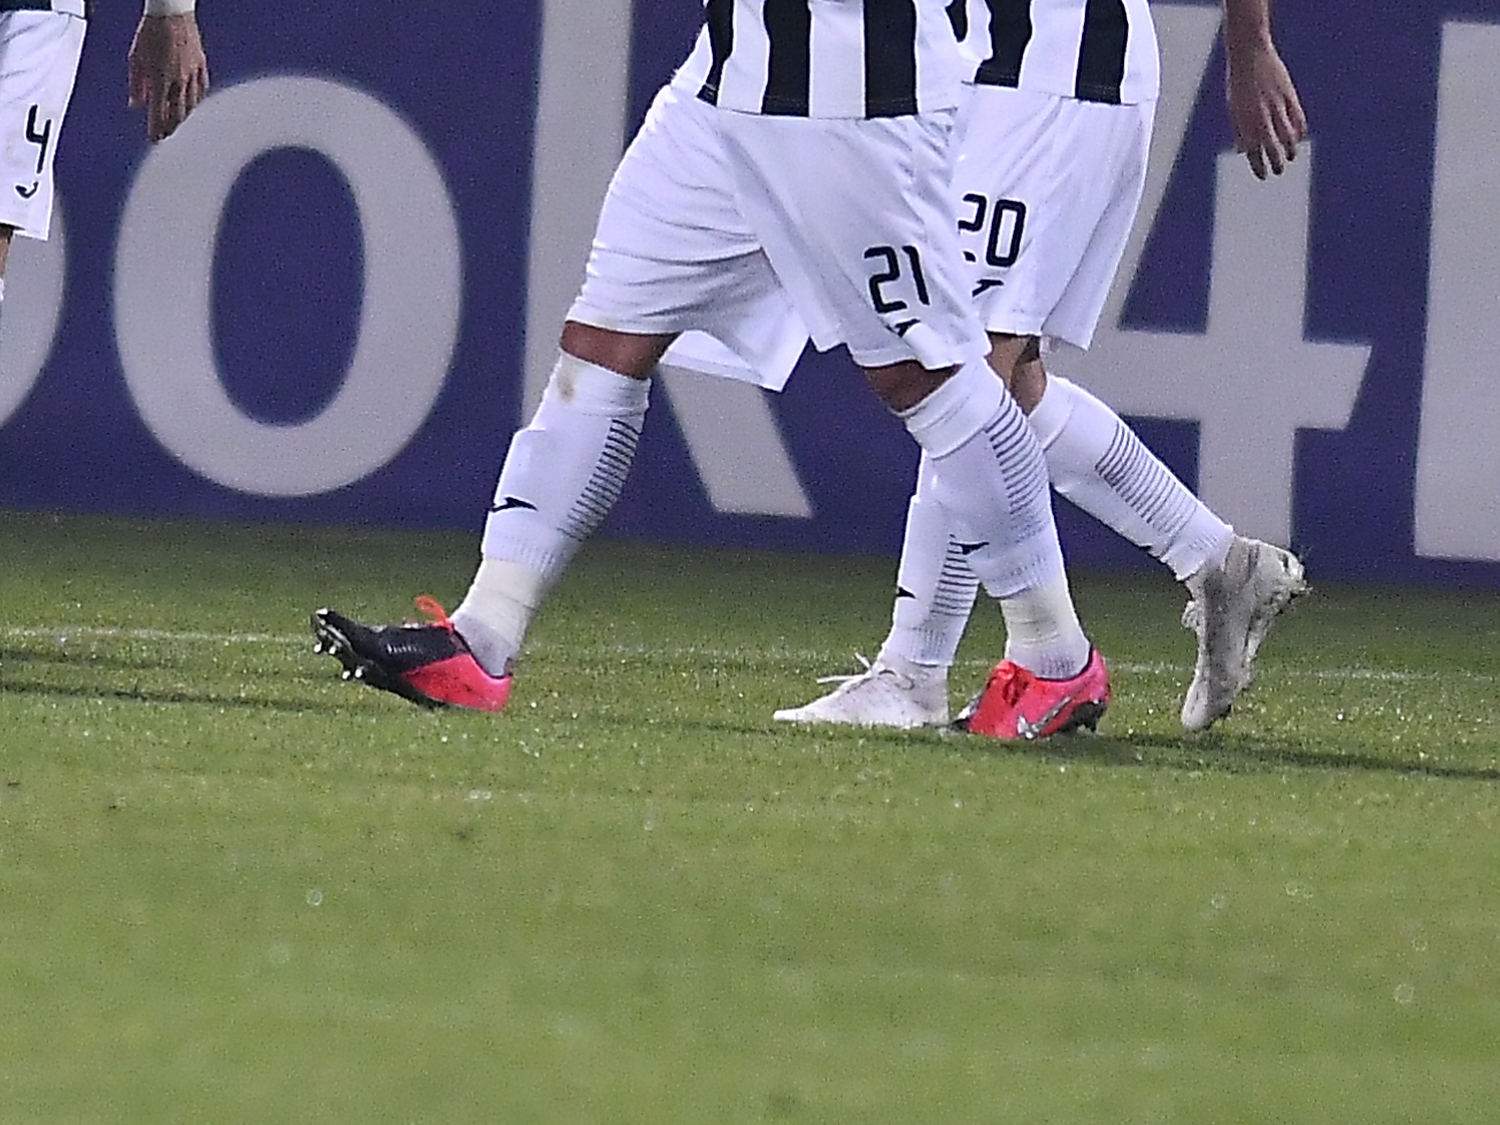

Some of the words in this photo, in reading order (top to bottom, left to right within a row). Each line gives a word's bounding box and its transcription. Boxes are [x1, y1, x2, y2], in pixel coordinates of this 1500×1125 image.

[25, 104, 52, 174] 4
[957, 193, 1027, 268] 20
[863, 245, 930, 314] 21
